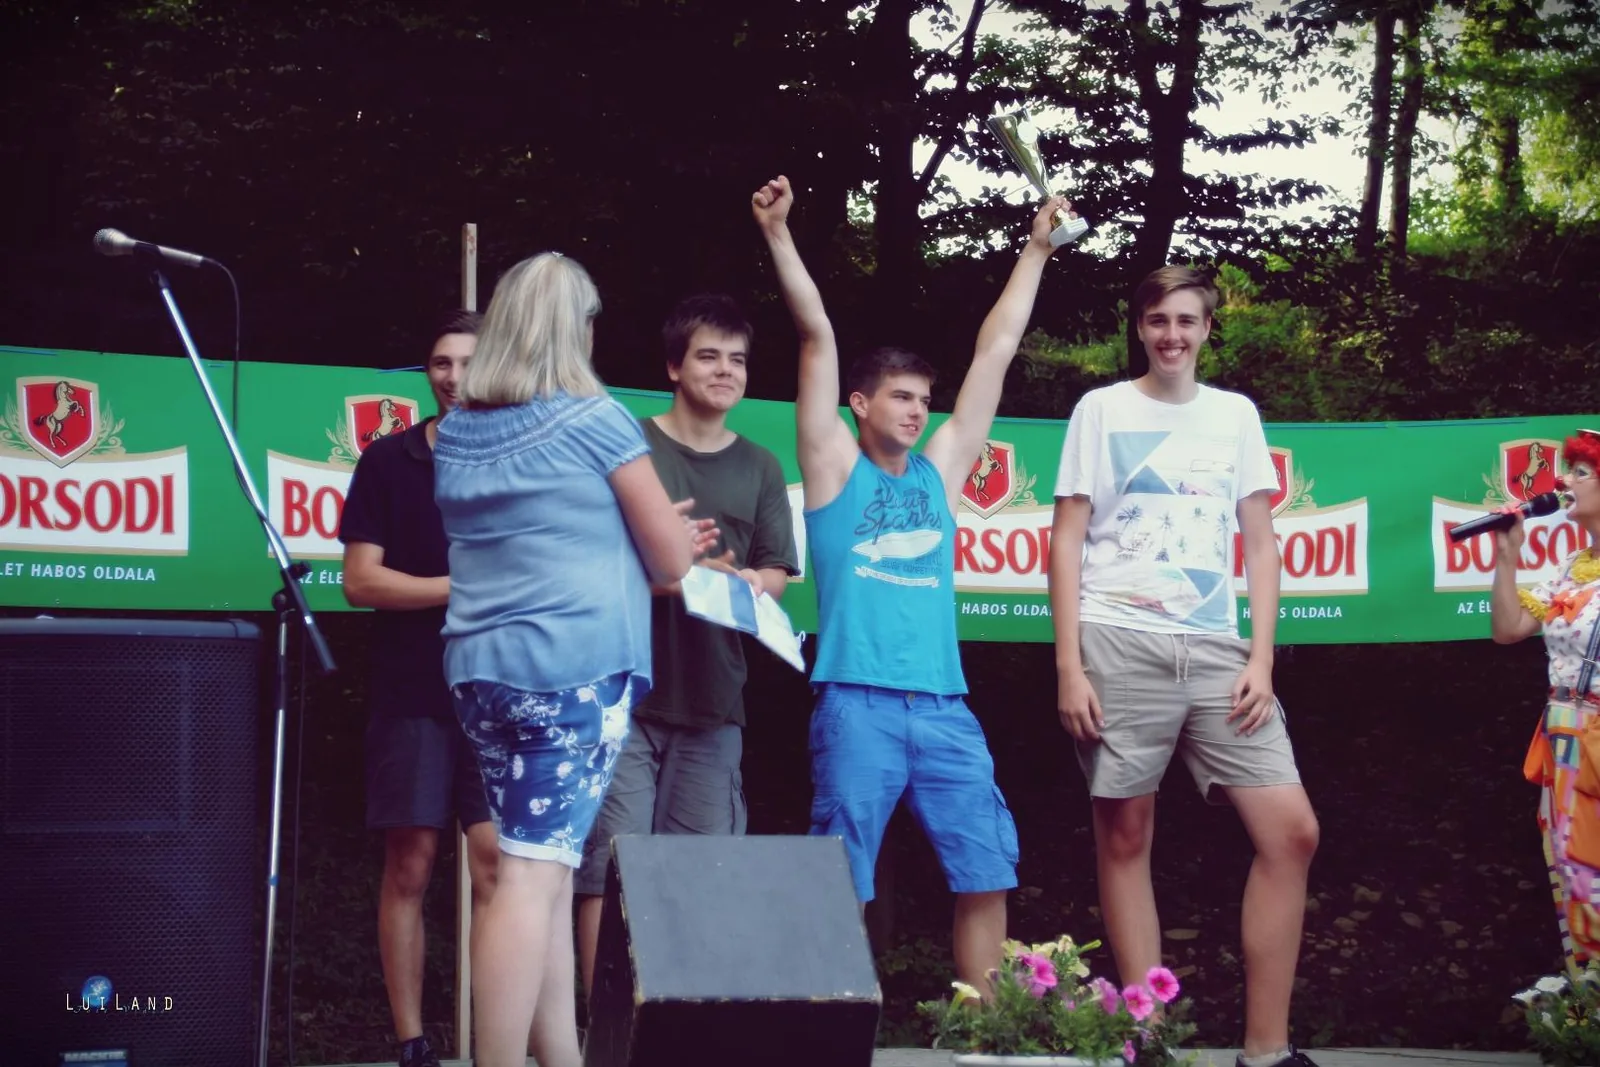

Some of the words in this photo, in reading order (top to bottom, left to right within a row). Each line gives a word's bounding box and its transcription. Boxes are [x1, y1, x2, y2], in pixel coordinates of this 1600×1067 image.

[31, 563, 87, 579] HABOS
[93, 566, 156, 581] OLDALA
[961, 602, 1008, 616] HABOS
[1013, 604, 1052, 616] OLDA
[1292, 606, 1343, 619] OLDALA
[1457, 602, 1474, 614] AZ
